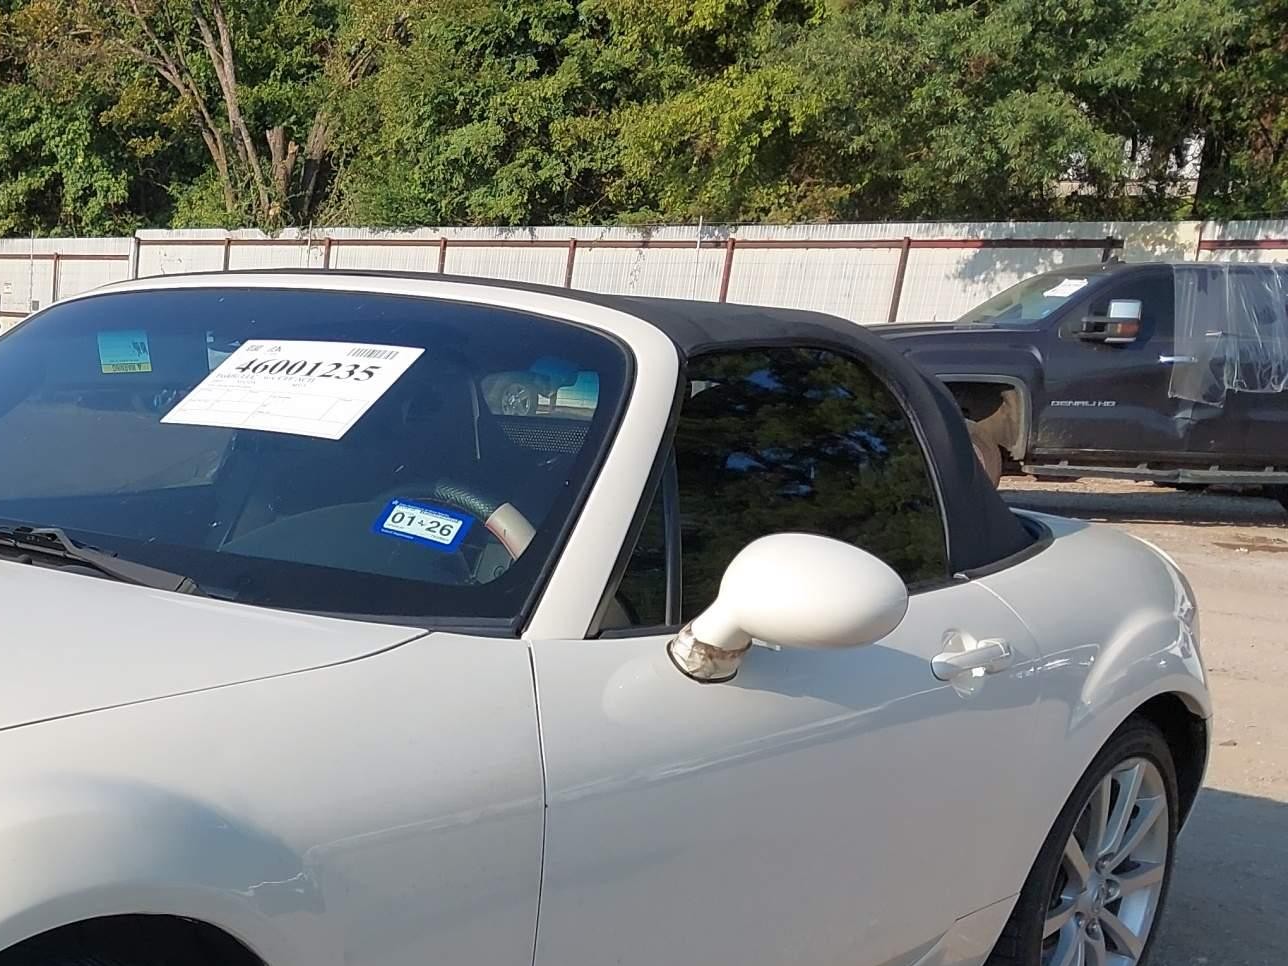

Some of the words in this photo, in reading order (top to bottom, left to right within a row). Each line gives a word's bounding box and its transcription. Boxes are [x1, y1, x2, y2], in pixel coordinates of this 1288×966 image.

[235, 357, 382, 382] 46001235
[391, 511, 416, 527] 01
[424, 520, 454, 537] 26
